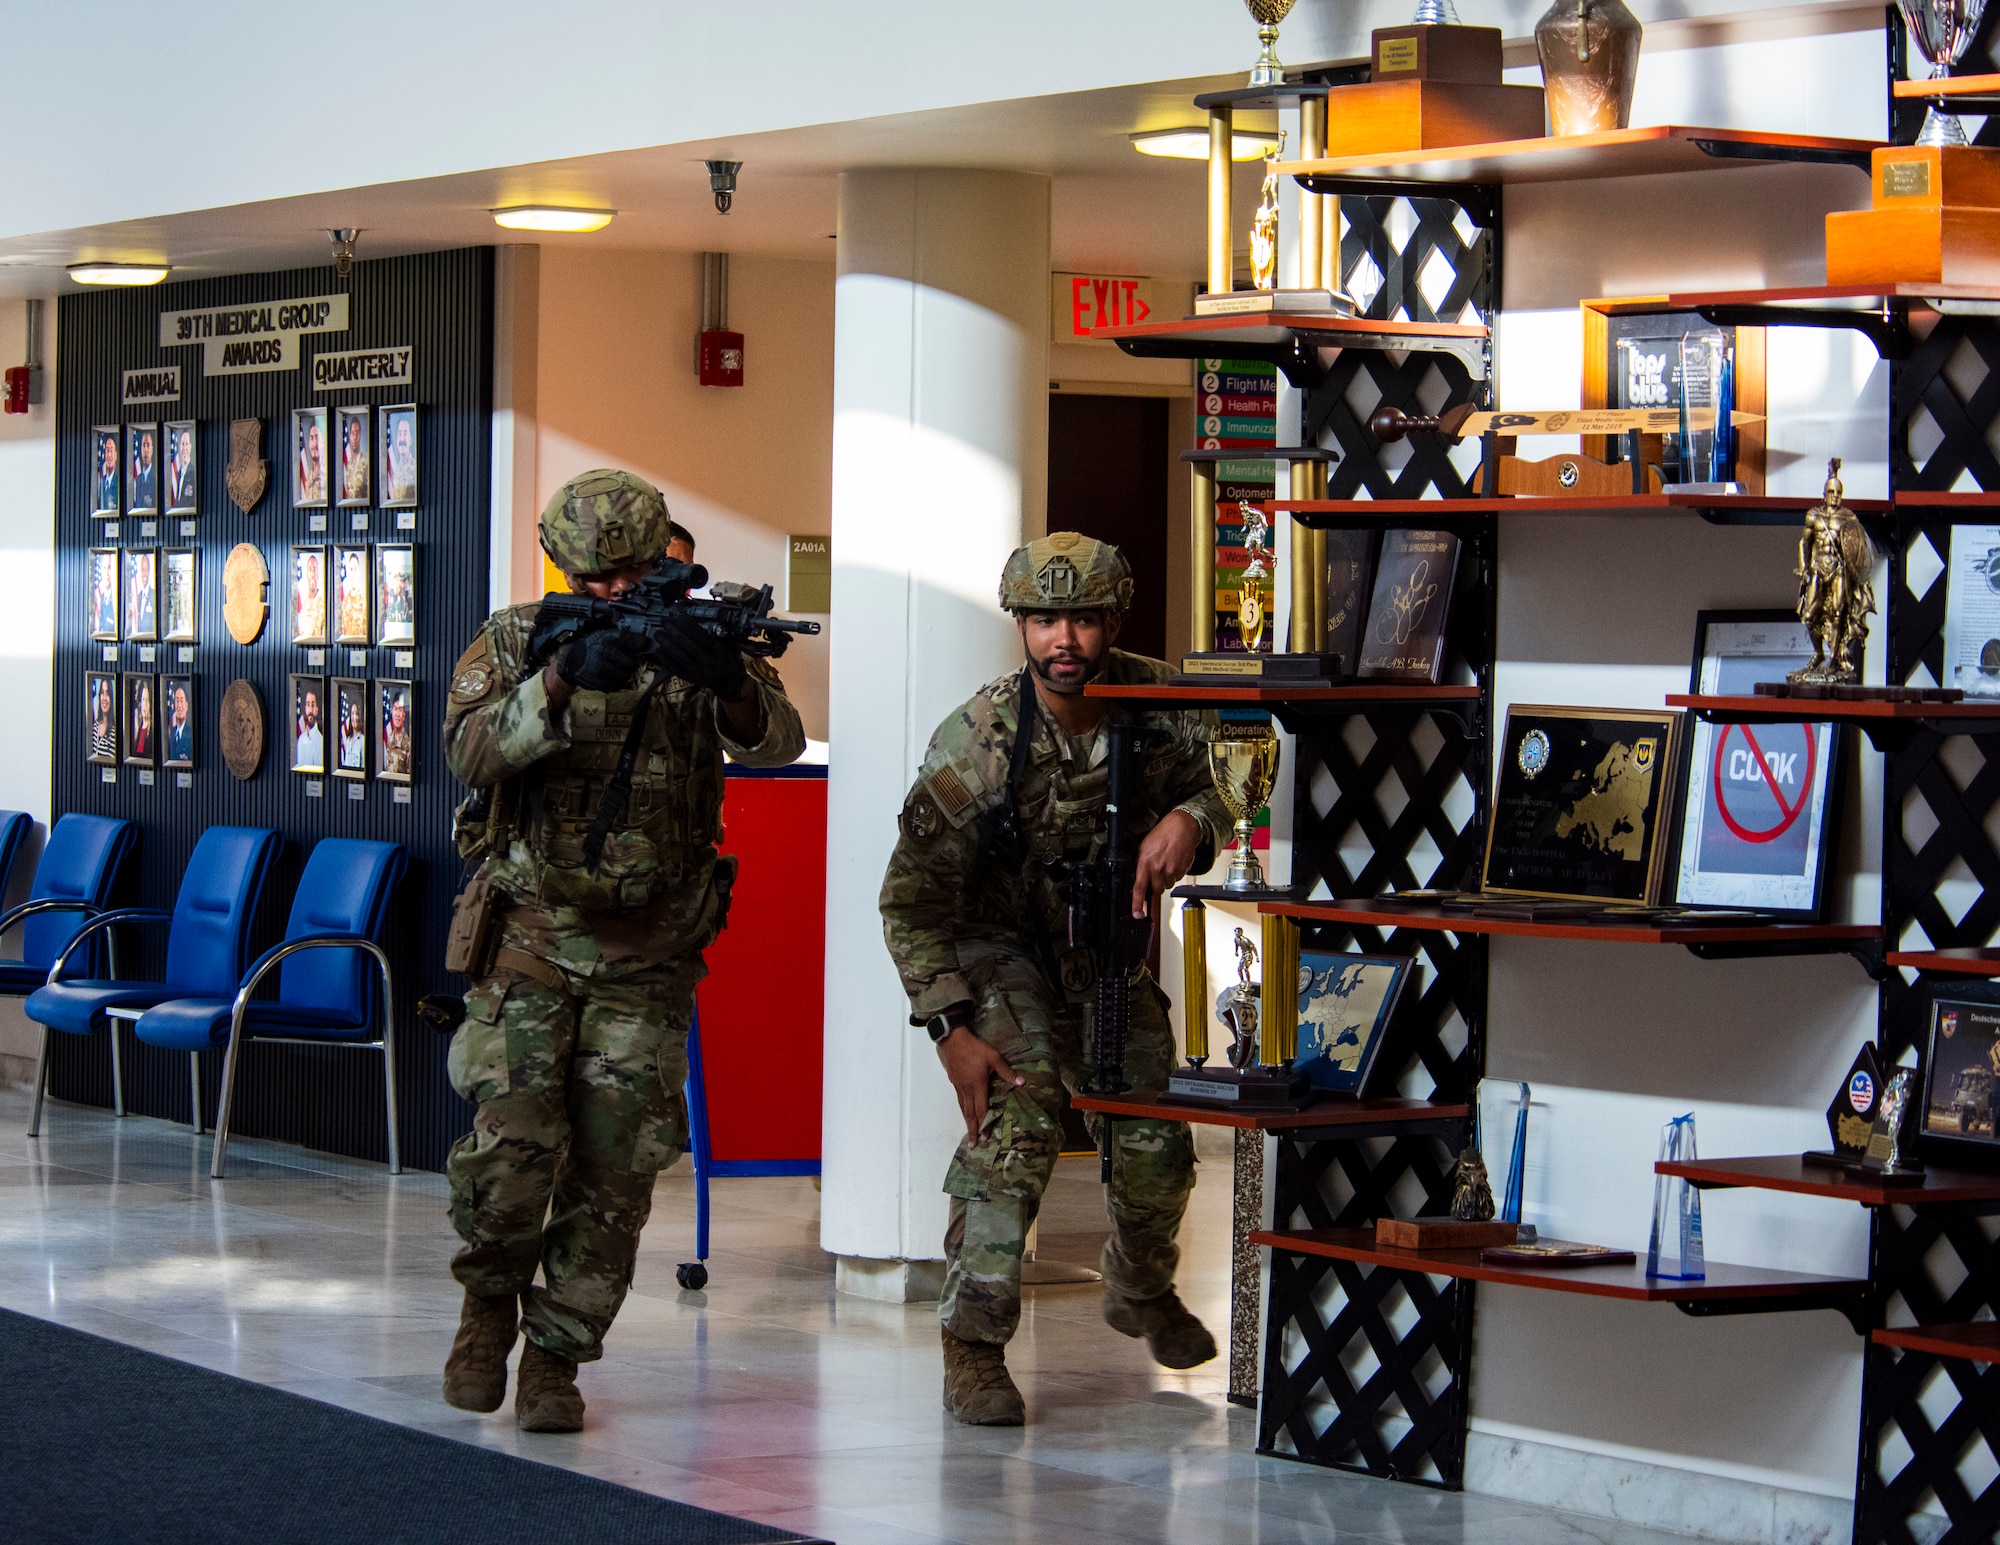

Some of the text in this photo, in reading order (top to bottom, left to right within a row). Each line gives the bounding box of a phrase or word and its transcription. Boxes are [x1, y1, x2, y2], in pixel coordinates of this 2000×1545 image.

[1072, 277, 1138, 336] EXIT
[176, 302, 330, 340] 39TH MEDICAL GROUP
[222, 339, 282, 367] AWARDS
[316, 352, 409, 385] QUARTERLY
[125, 372, 179, 398] ANNUAL
[1207, 376, 1214, 389] 2
[1226, 377, 1257, 394] Flight
[1629, 376, 1668, 404] blue
[1210, 398, 1217, 411] 2
[1228, 400, 1260, 411] Health
[1209, 420, 1217, 432] 2
[1226, 465, 1260, 476] Mental
[794, 542, 826, 552] 2A01A
[1246, 602, 1254, 623] 3
[1408, 657, 1430, 673] Turkey
[1729, 749, 1798, 784] COOK
